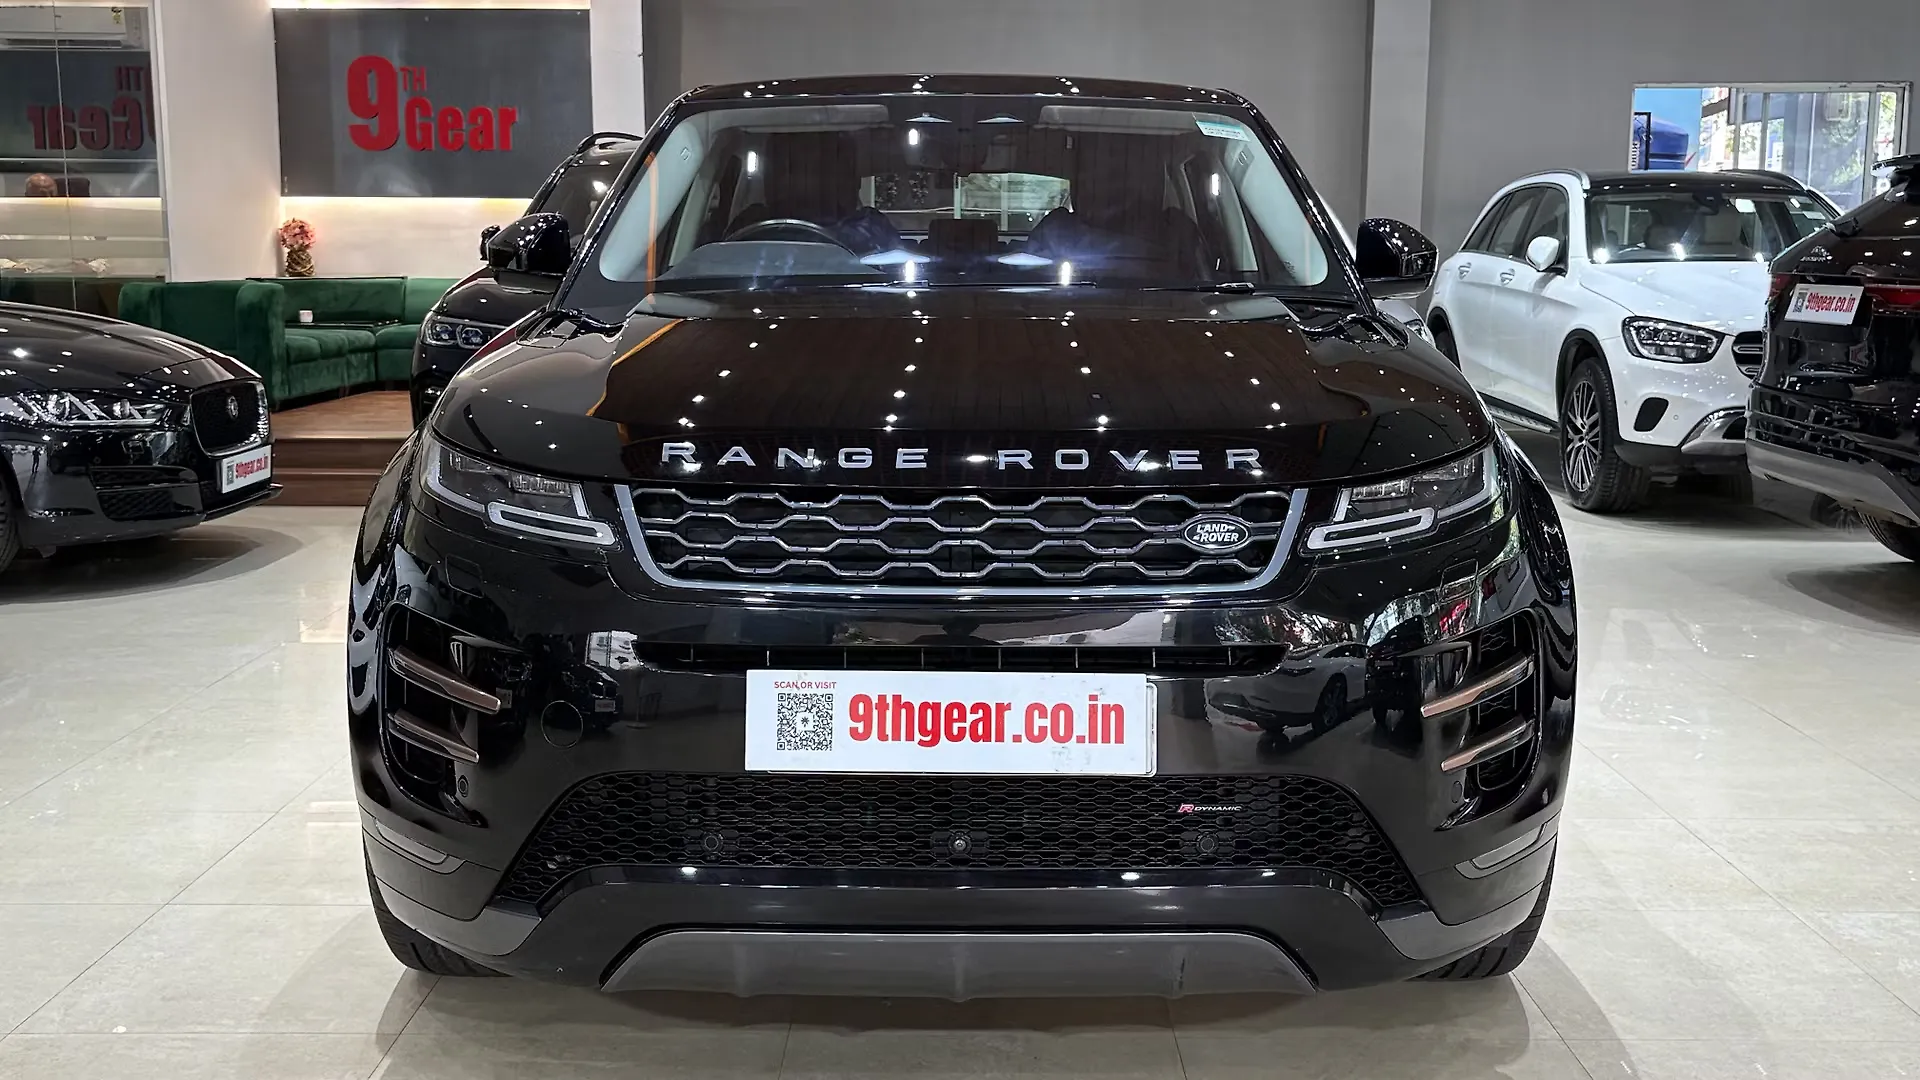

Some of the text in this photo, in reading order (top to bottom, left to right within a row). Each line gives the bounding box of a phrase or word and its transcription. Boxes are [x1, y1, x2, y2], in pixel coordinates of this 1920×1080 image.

[404, 96, 518, 152] Gear
[661, 442, 1263, 472] RANGE ROVER
[1196, 523, 1228, 533] LAND
[1201, 532, 1239, 542] ROVER
[774, 681, 837, 690] SCAN OR VISIT
[849, 693, 1125, 748] 9thgear.co.in
